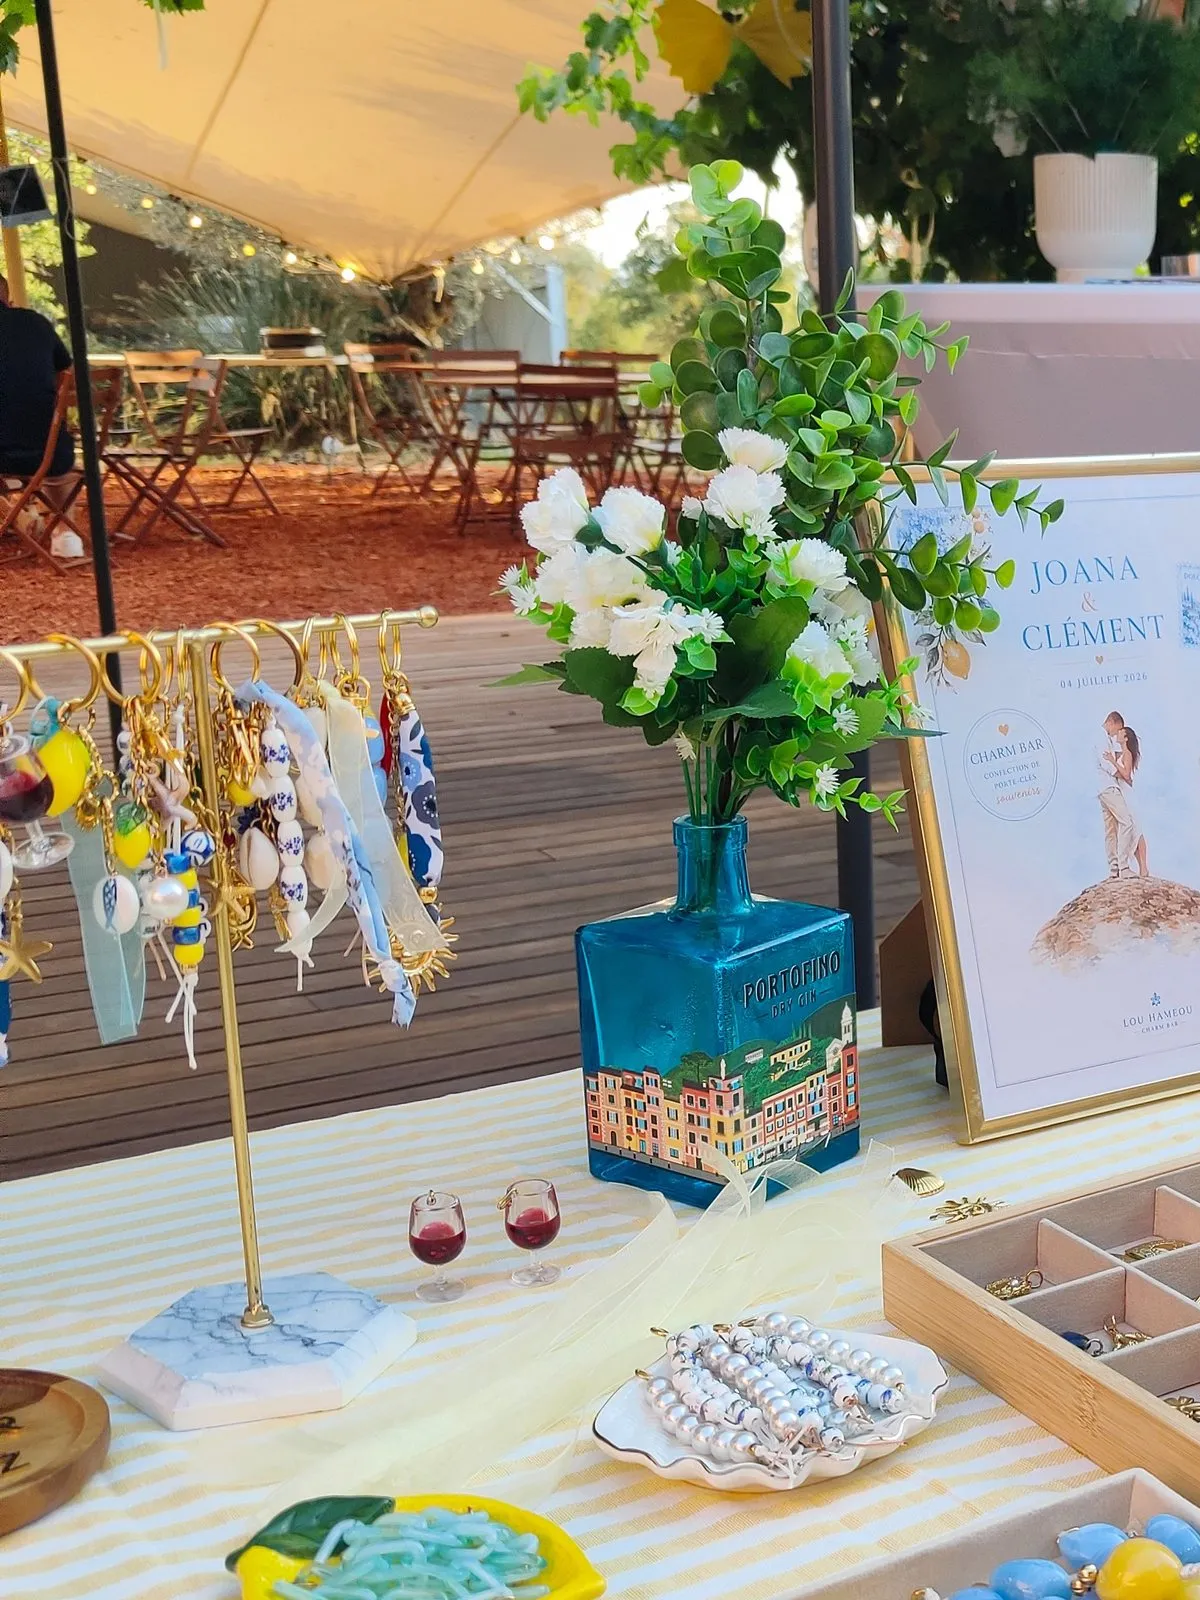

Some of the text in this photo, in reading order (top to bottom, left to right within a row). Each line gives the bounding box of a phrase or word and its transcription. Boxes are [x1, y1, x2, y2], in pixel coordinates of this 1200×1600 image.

[1031, 556, 1138, 594] JOANA
[1081, 591, 1098, 612] &
[1022, 614, 1164, 650] CLÉMENT
[1060, 672, 1148, 689] 04 JUILLET 2026
[970, 738, 1044, 765] CHARM BAR
[983, 760, 1040, 780] CONFECTION DE
[743, 950, 840, 1009] PORTOFINO
[771, 989, 816, 1018] DRY GIN
[1123, 1005, 1193, 1028] LOU HAMEOU
[1141, 1020, 1178, 1033] CHARM BAR
